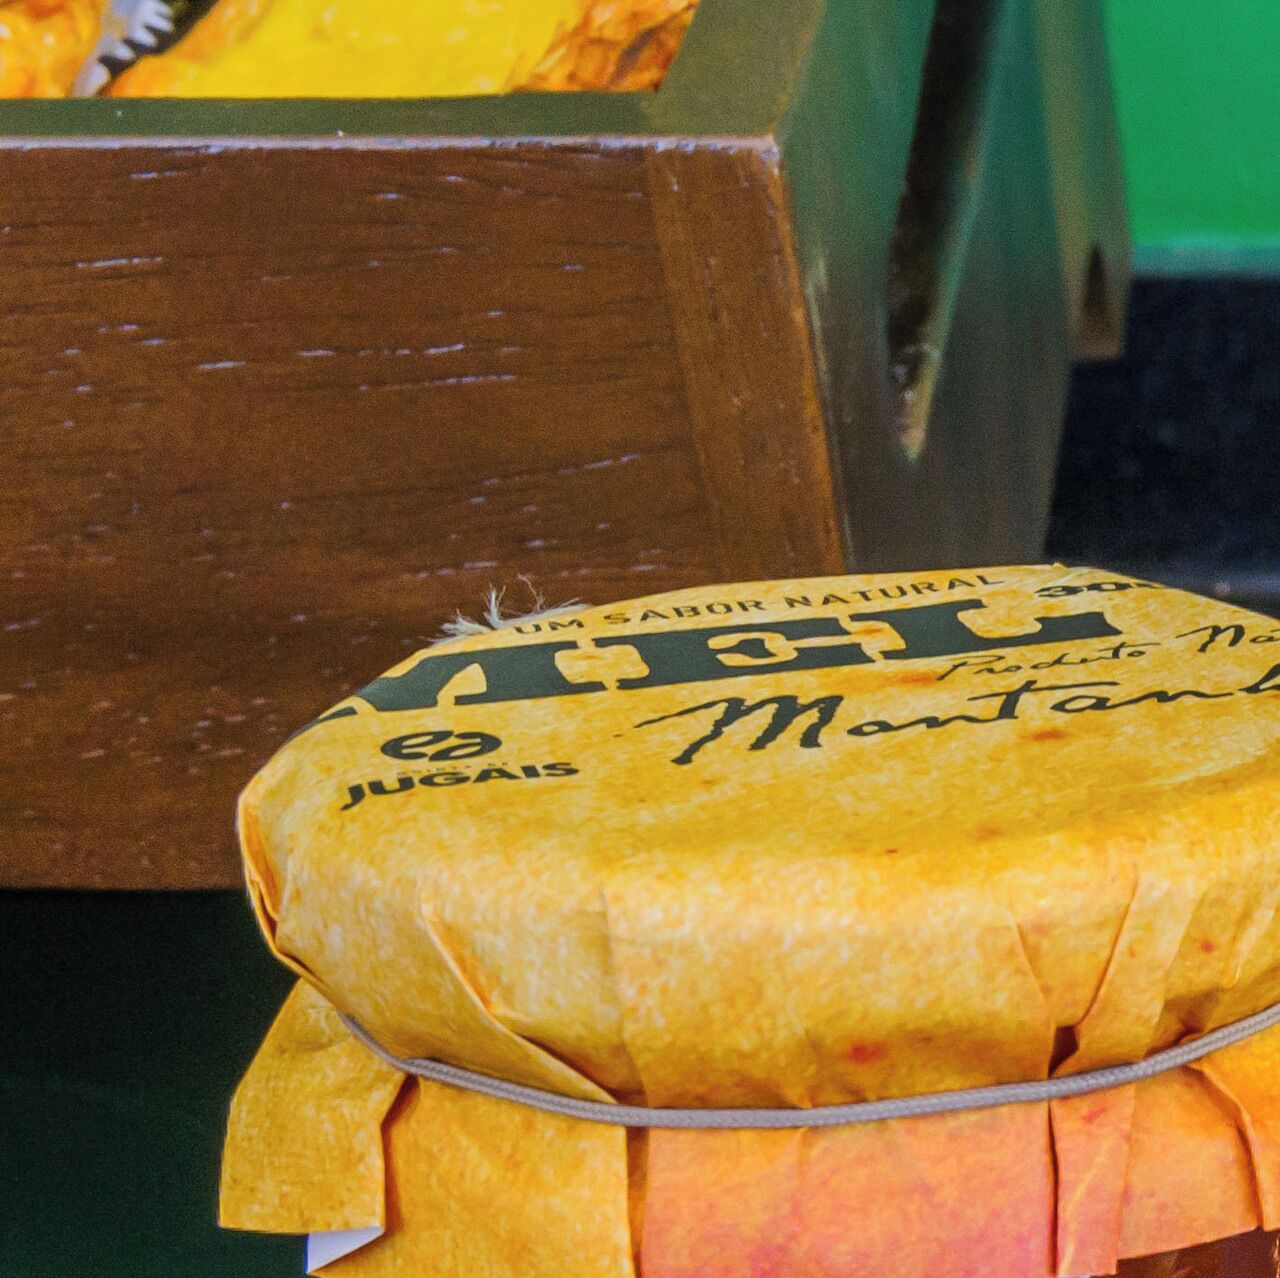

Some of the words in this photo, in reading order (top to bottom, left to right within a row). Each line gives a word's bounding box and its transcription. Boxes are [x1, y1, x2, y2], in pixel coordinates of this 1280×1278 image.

[513, 617, 585, 636] UM
[603, 598, 764, 625] SABOR
[782, 573, 1006, 609] NATURAL
[936, 641, 1162, 682] Produto
[341, 761, 581, 812] JUGAIS
